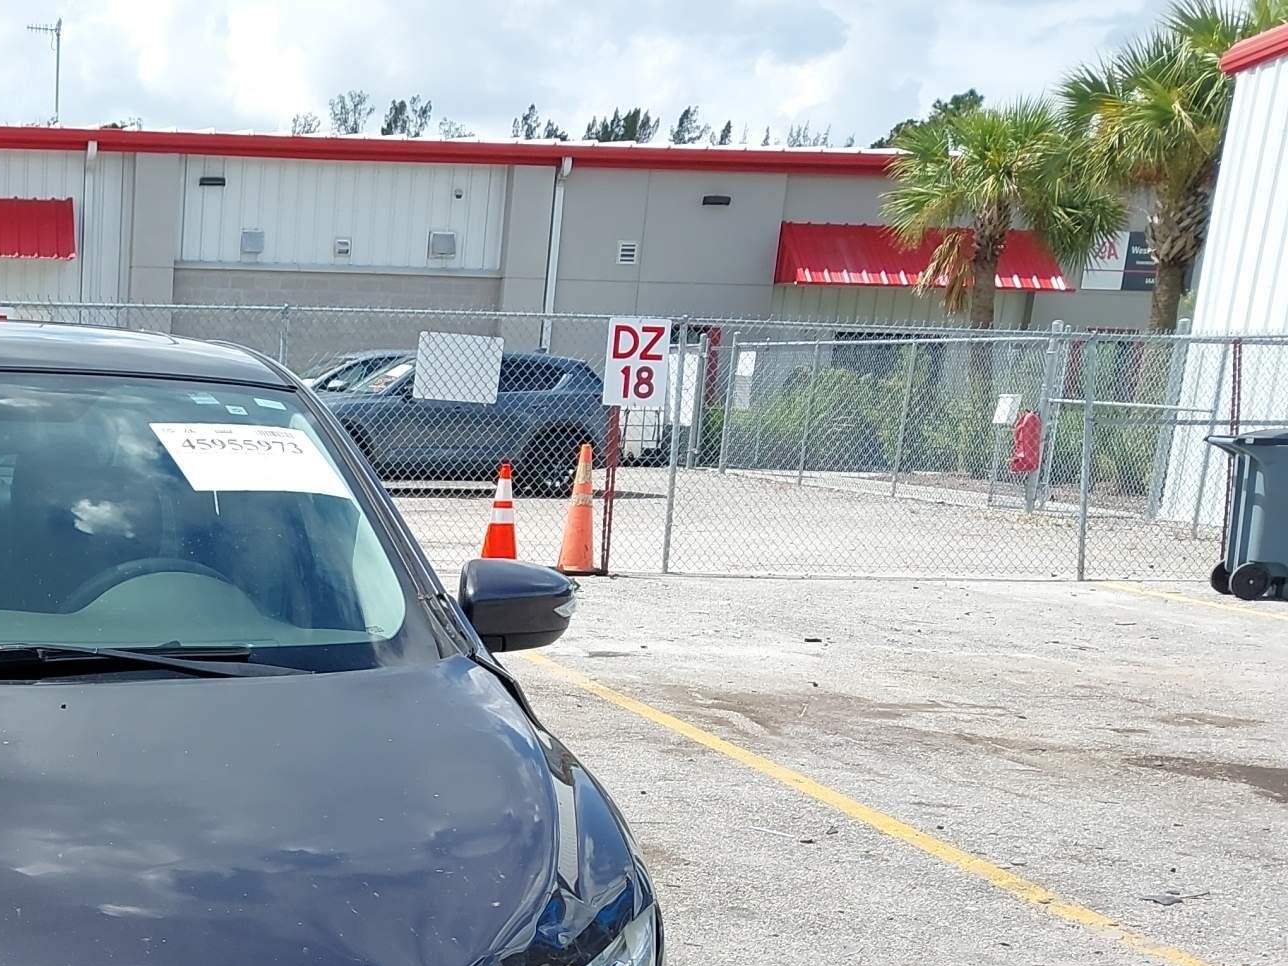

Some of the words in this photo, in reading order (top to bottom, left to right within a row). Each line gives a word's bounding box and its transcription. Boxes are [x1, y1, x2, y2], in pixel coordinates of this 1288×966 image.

[612, 324, 666, 361] DZ
[620, 365, 655, 400] 18
[181, 438, 304, 455] 45955973
